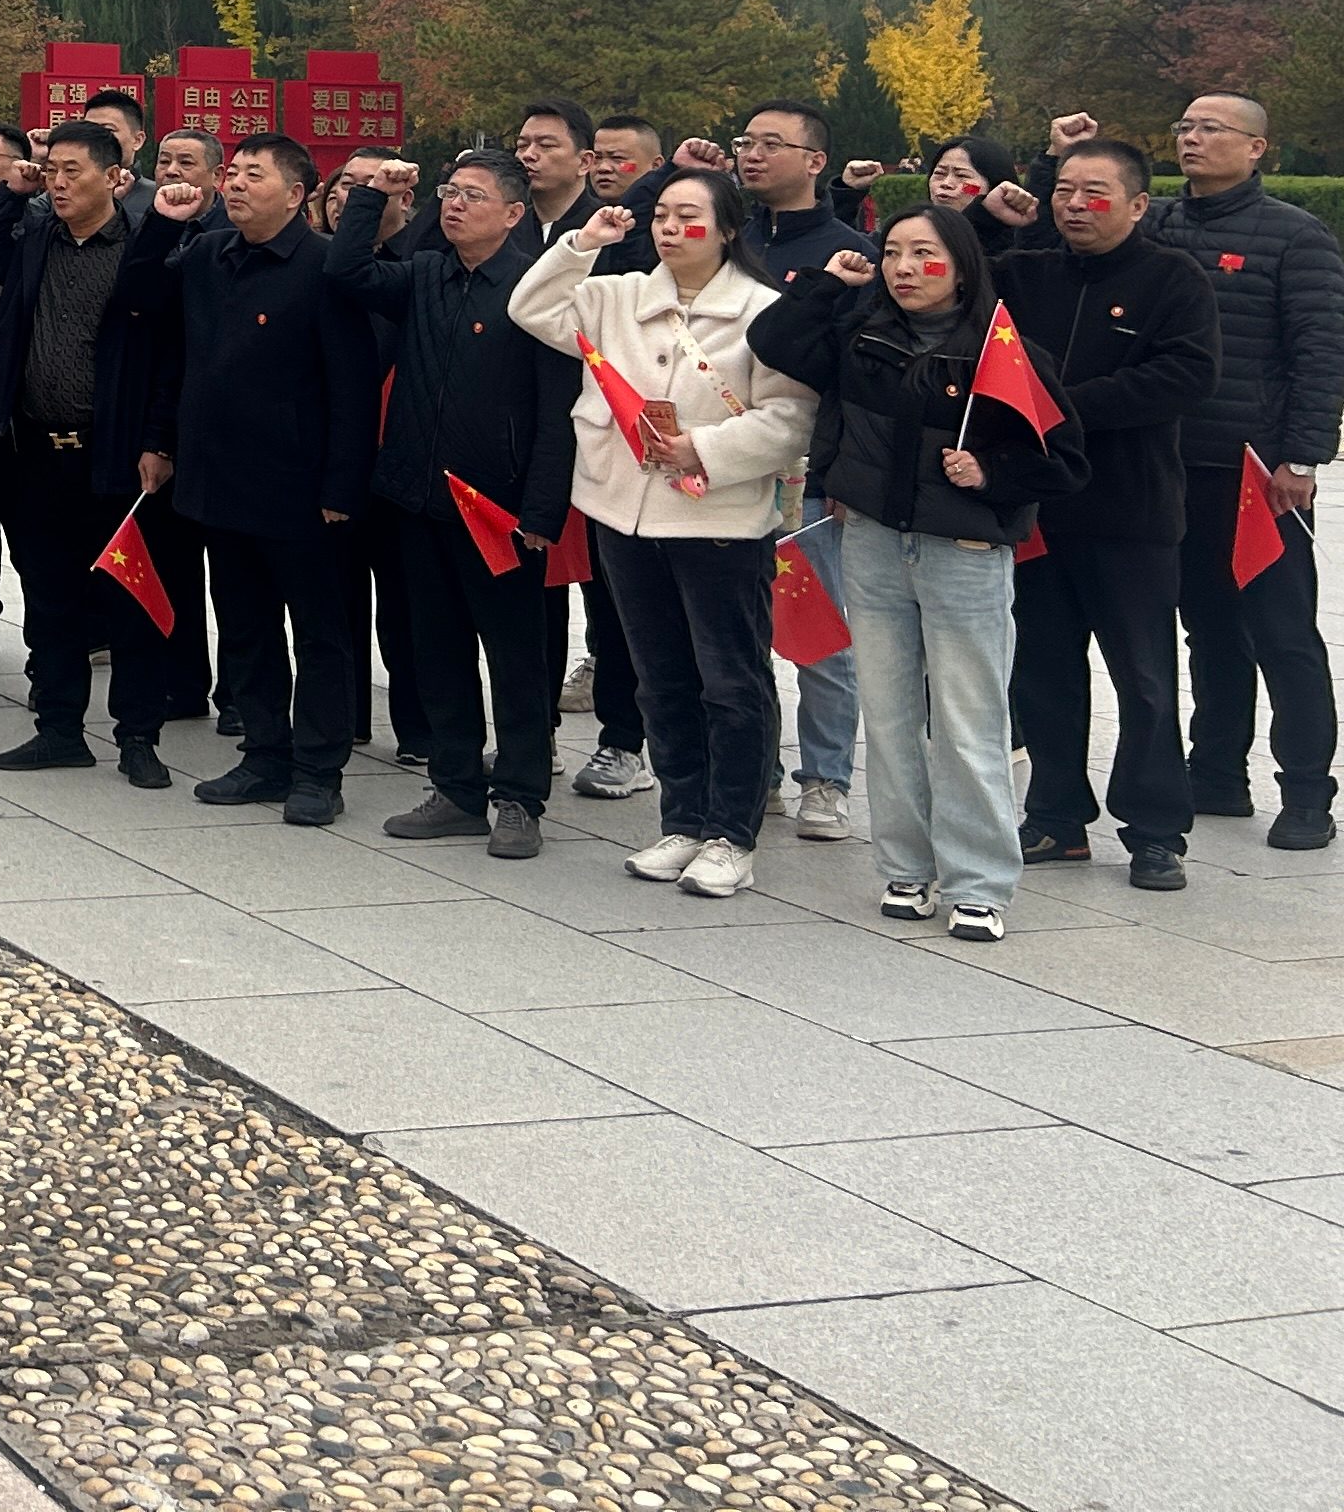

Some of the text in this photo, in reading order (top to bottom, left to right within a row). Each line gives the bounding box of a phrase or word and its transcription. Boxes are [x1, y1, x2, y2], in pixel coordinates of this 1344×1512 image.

[48, 83, 87, 104] 富强
[184, 86, 269, 109] 自由 公正
[311, 89, 397, 111] 爱国 诚信
[182, 113, 269, 135] 平等 法治
[312, 115, 397, 138] 敬业 友善
